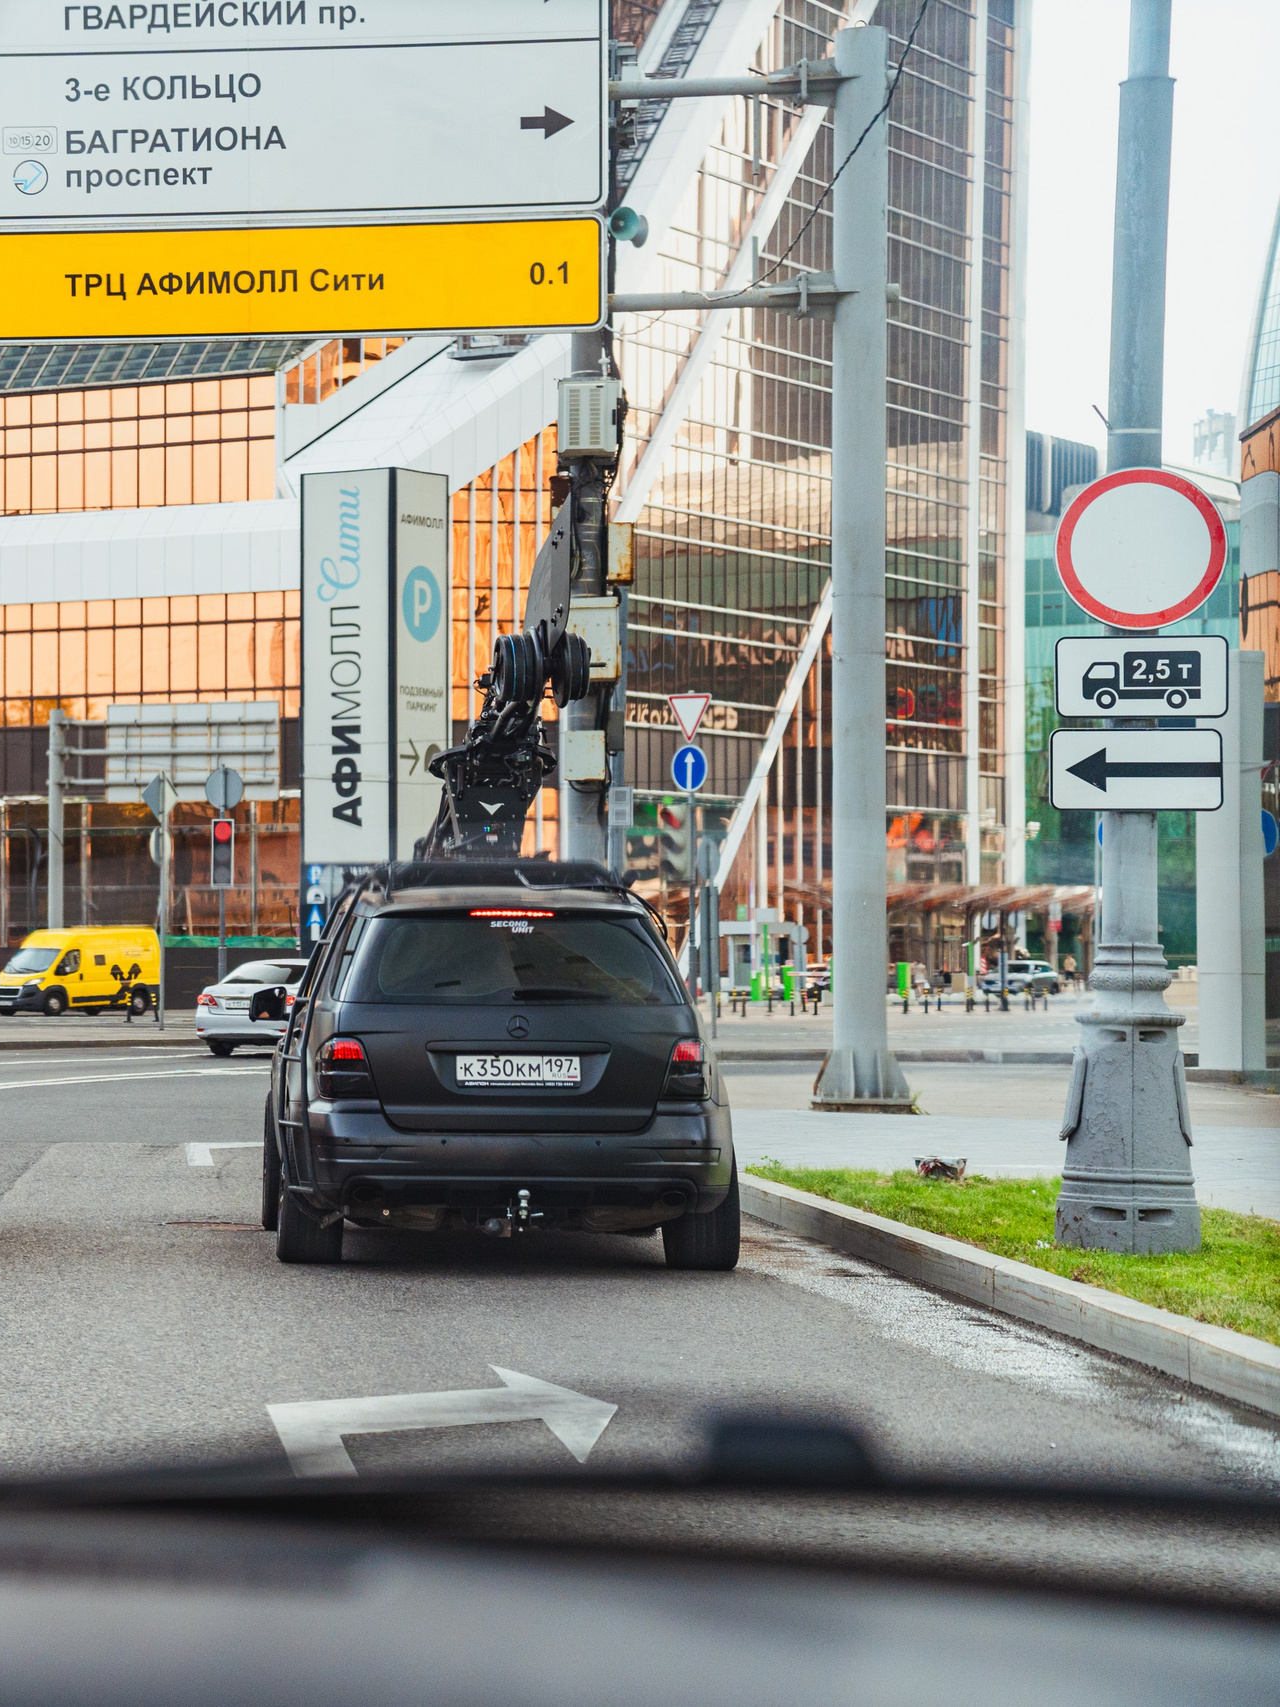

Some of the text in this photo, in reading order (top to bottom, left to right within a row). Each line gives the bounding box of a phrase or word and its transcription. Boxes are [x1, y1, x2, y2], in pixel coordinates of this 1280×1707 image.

[319, 4, 366, 30] пр.
[65, 73, 262, 103] 3-е КОЛЬЦО
[21, 136, 31, 146] 15
[35, 135, 51, 146] 20
[66, 125, 287, 155] БАГРАТИОНА
[66, 167, 213, 194] проспект
[65, 268, 385, 300] ТРЦ АФИМОЛЛ Сити
[529, 261, 571, 286] 0.1
[401, 513, 445, 530] АФИМОЛЛ
[317, 486, 360, 602] Сити
[1132, 659, 1170, 683] 2,5
[400, 684, 445, 699] ПОДЗЕМНЫЙ
[330, 605, 362, 828] АФИМОЛЛ
[406, 701, 438, 712] ПАРКИНГ
[490, 920, 528, 928] SECOND
[511, 926, 535, 934] UNIT
[464, 1059, 541, 1078] К350КМ
[545, 1059, 574, 1073] 197
